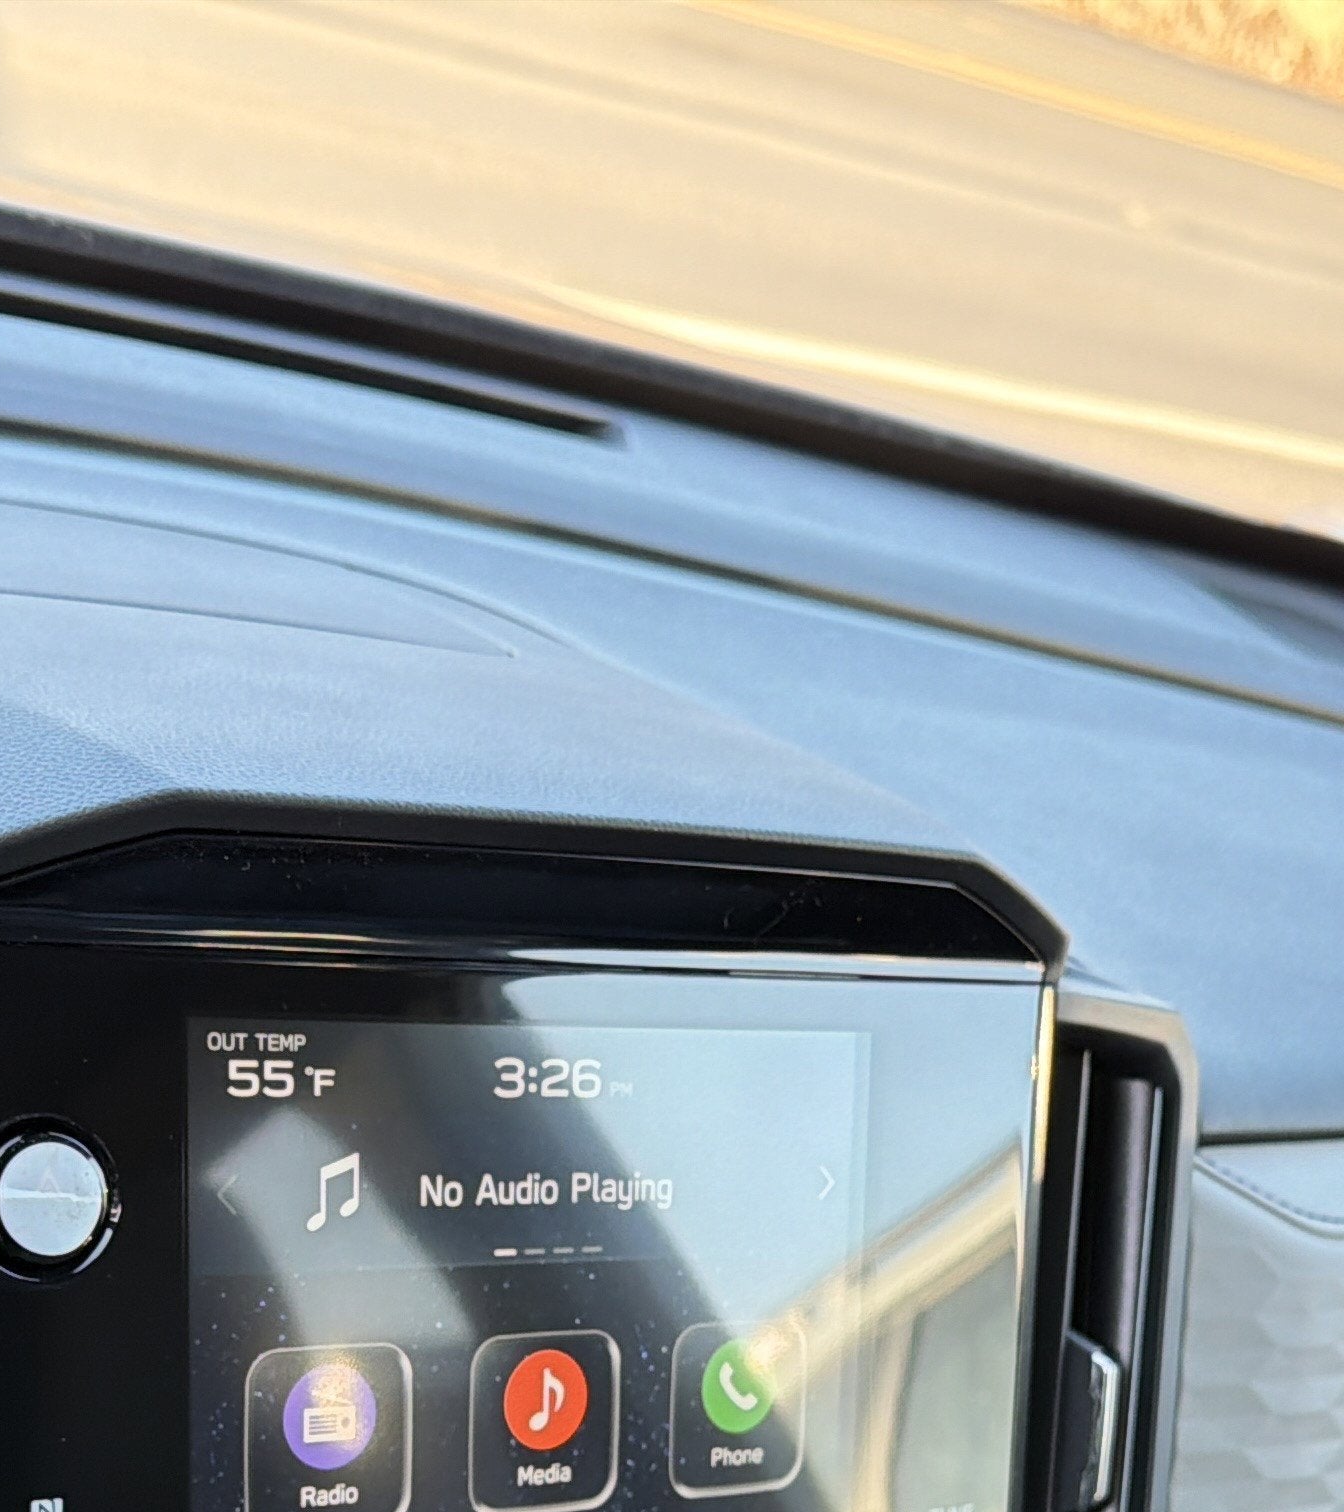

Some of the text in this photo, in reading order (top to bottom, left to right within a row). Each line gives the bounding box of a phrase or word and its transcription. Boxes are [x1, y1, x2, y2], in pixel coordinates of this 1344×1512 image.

[207, 1031, 306, 1052] OUT TEMP
[227, 1059, 295, 1097] 55
[494, 1057, 602, 1098] 3:26
[420, 1171, 673, 1211] No Audio Playing
[711, 1445, 763, 1467] Phone
[517, 1463, 572, 1487] Media
[300, 1484, 358, 1508] Radio
